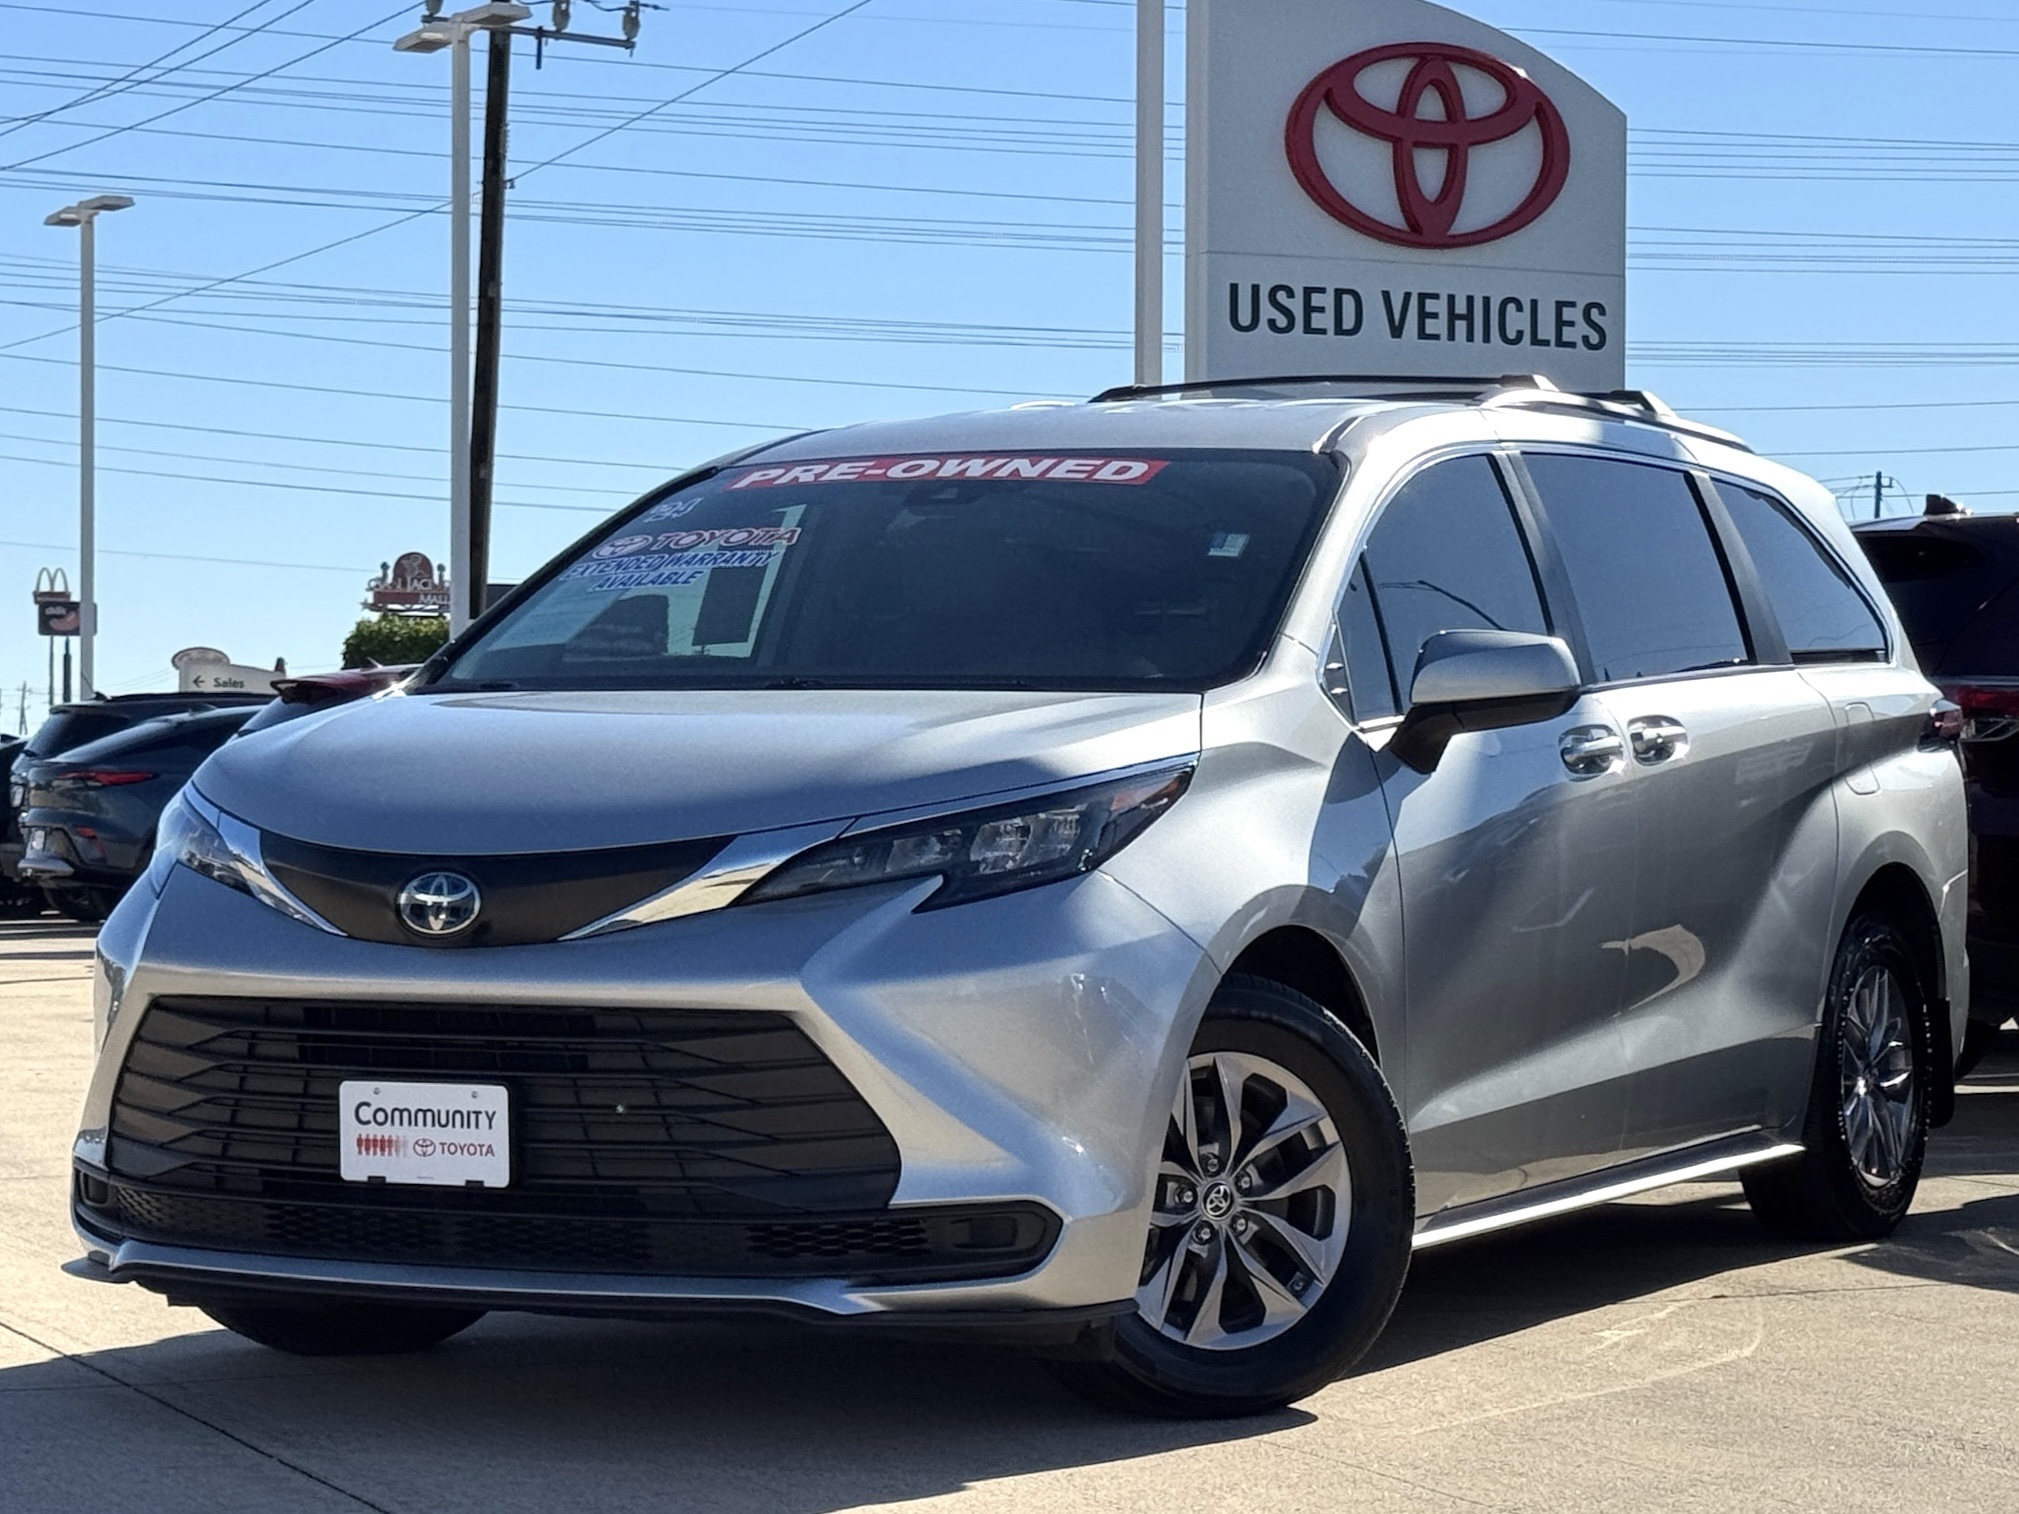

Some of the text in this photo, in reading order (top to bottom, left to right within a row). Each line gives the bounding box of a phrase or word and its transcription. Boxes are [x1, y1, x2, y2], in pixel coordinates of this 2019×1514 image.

[1229, 282, 1607, 351] USED VEHICLES
[731, 459, 1149, 490] PRE-OWNED
[650, 527, 801, 550] TOYOTA
[560, 550, 784, 580] EXTENDED WARRANTY
[588, 570, 704, 592] AVAILABLE
[213, 677, 245, 689] Sales
[439, 1142, 496, 1157] TOYOTA
